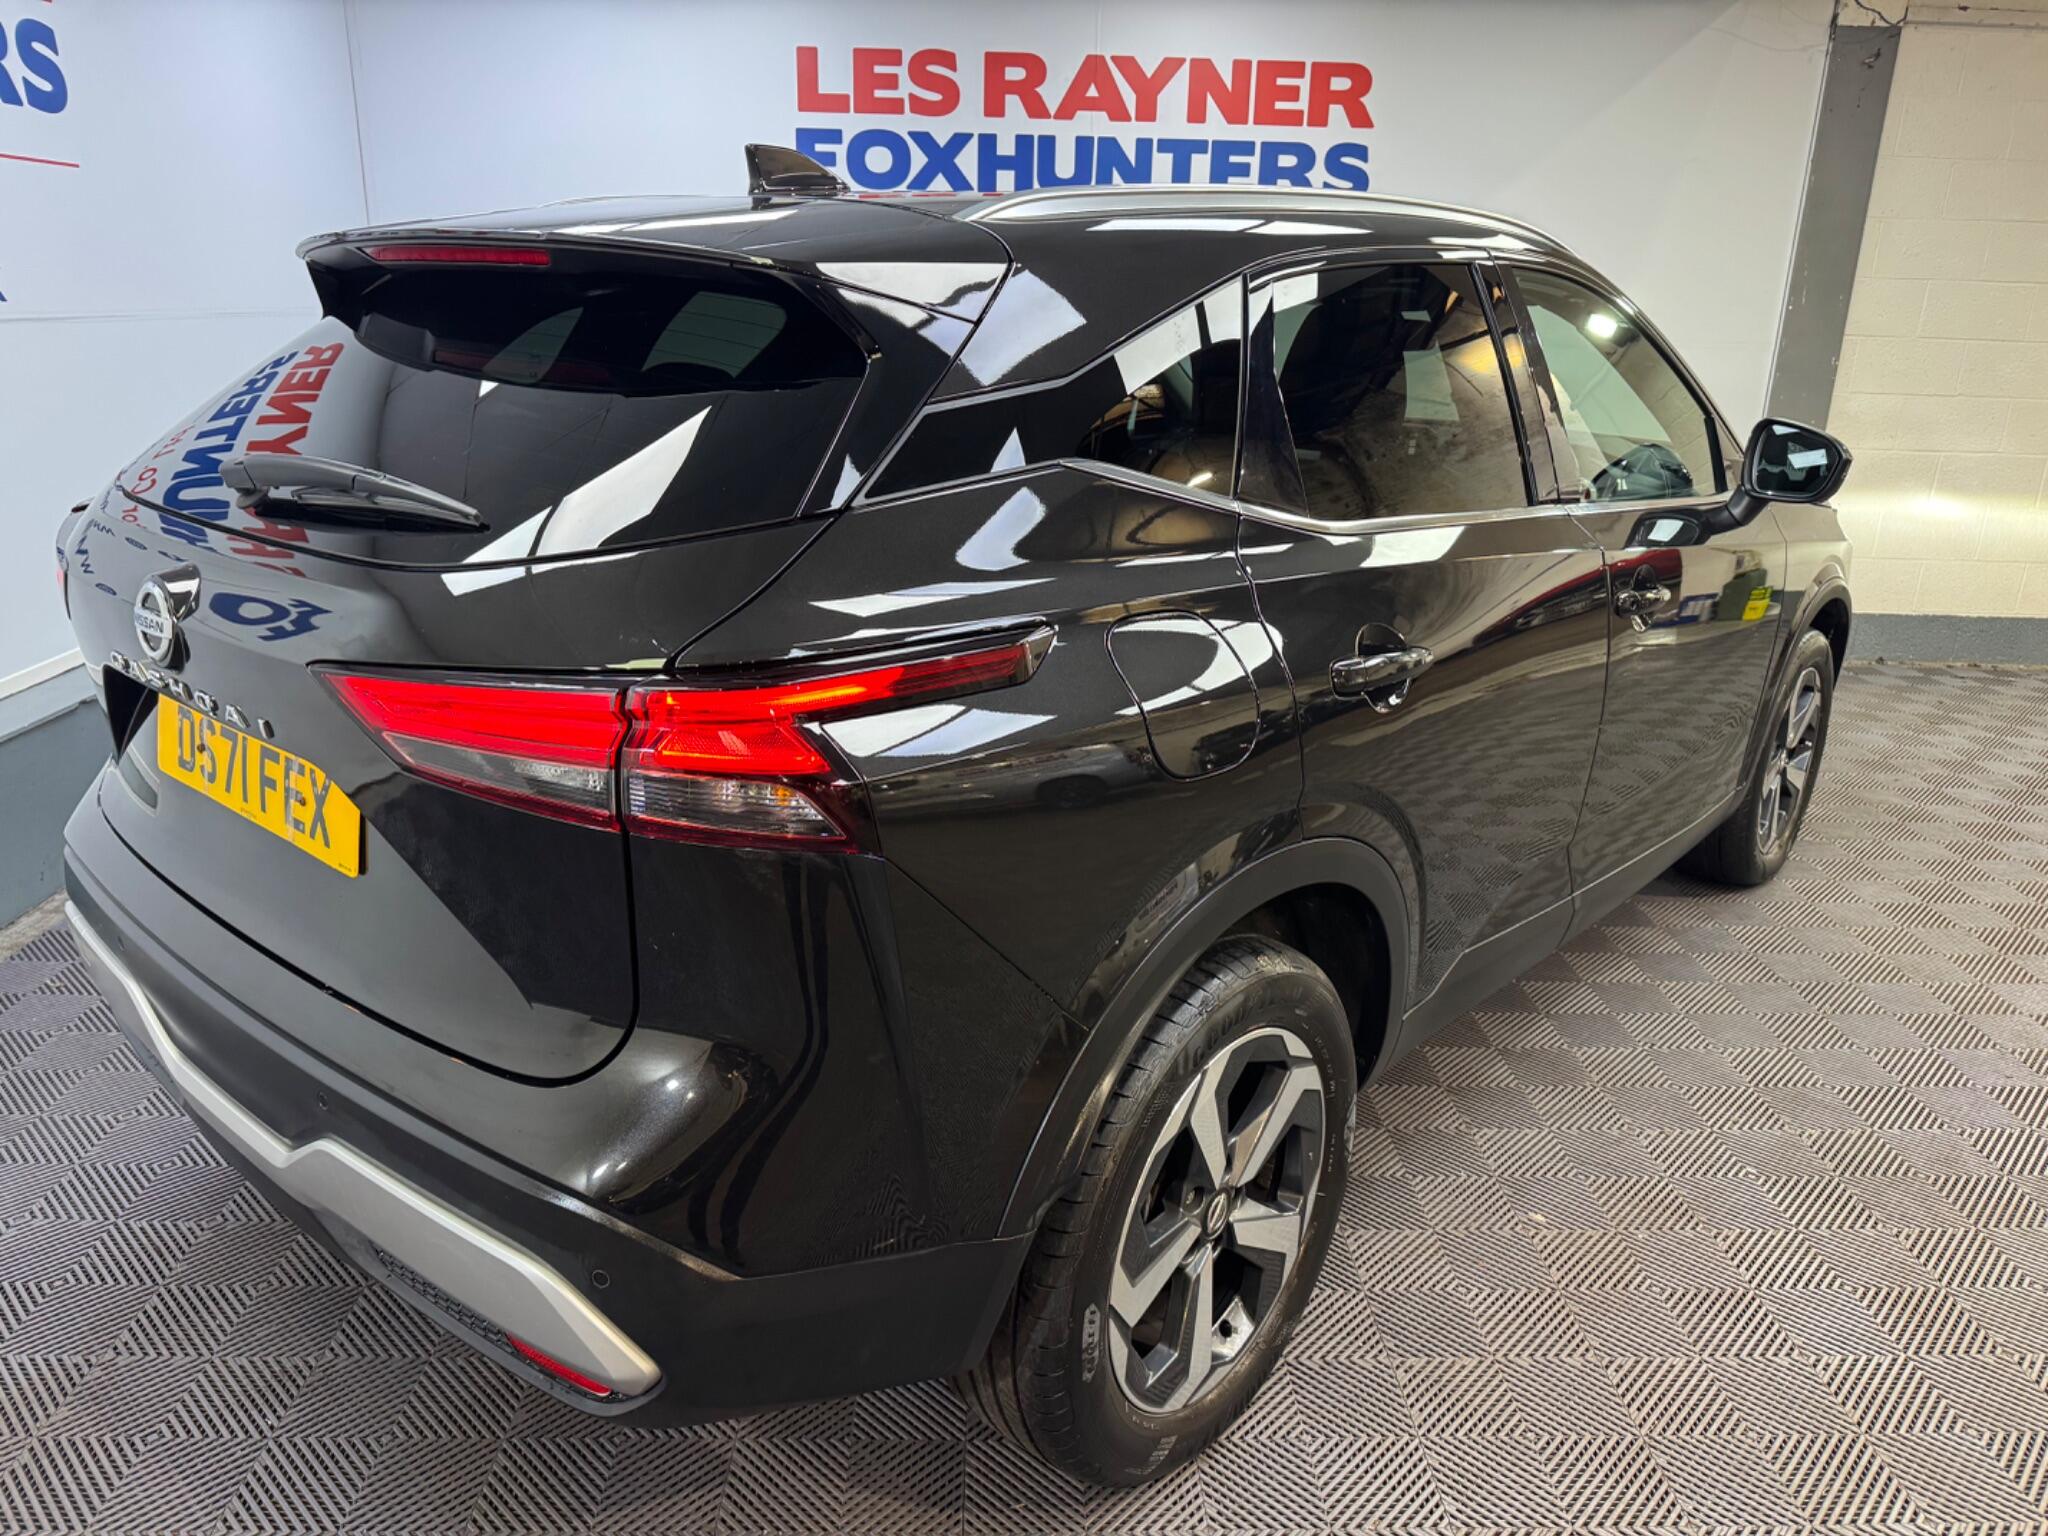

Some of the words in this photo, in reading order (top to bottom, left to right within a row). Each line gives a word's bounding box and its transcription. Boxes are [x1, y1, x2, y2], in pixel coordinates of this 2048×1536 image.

[796, 46, 960, 118] LES
[983, 50, 1375, 129] RAYNER
[795, 127, 1371, 193] FOXHUNTERS
[134, 612, 165, 634] NISSAN
[110, 650, 276, 739] QASHQAI
[177, 705, 250, 804] DS71
[260, 747, 331, 849] FEX
